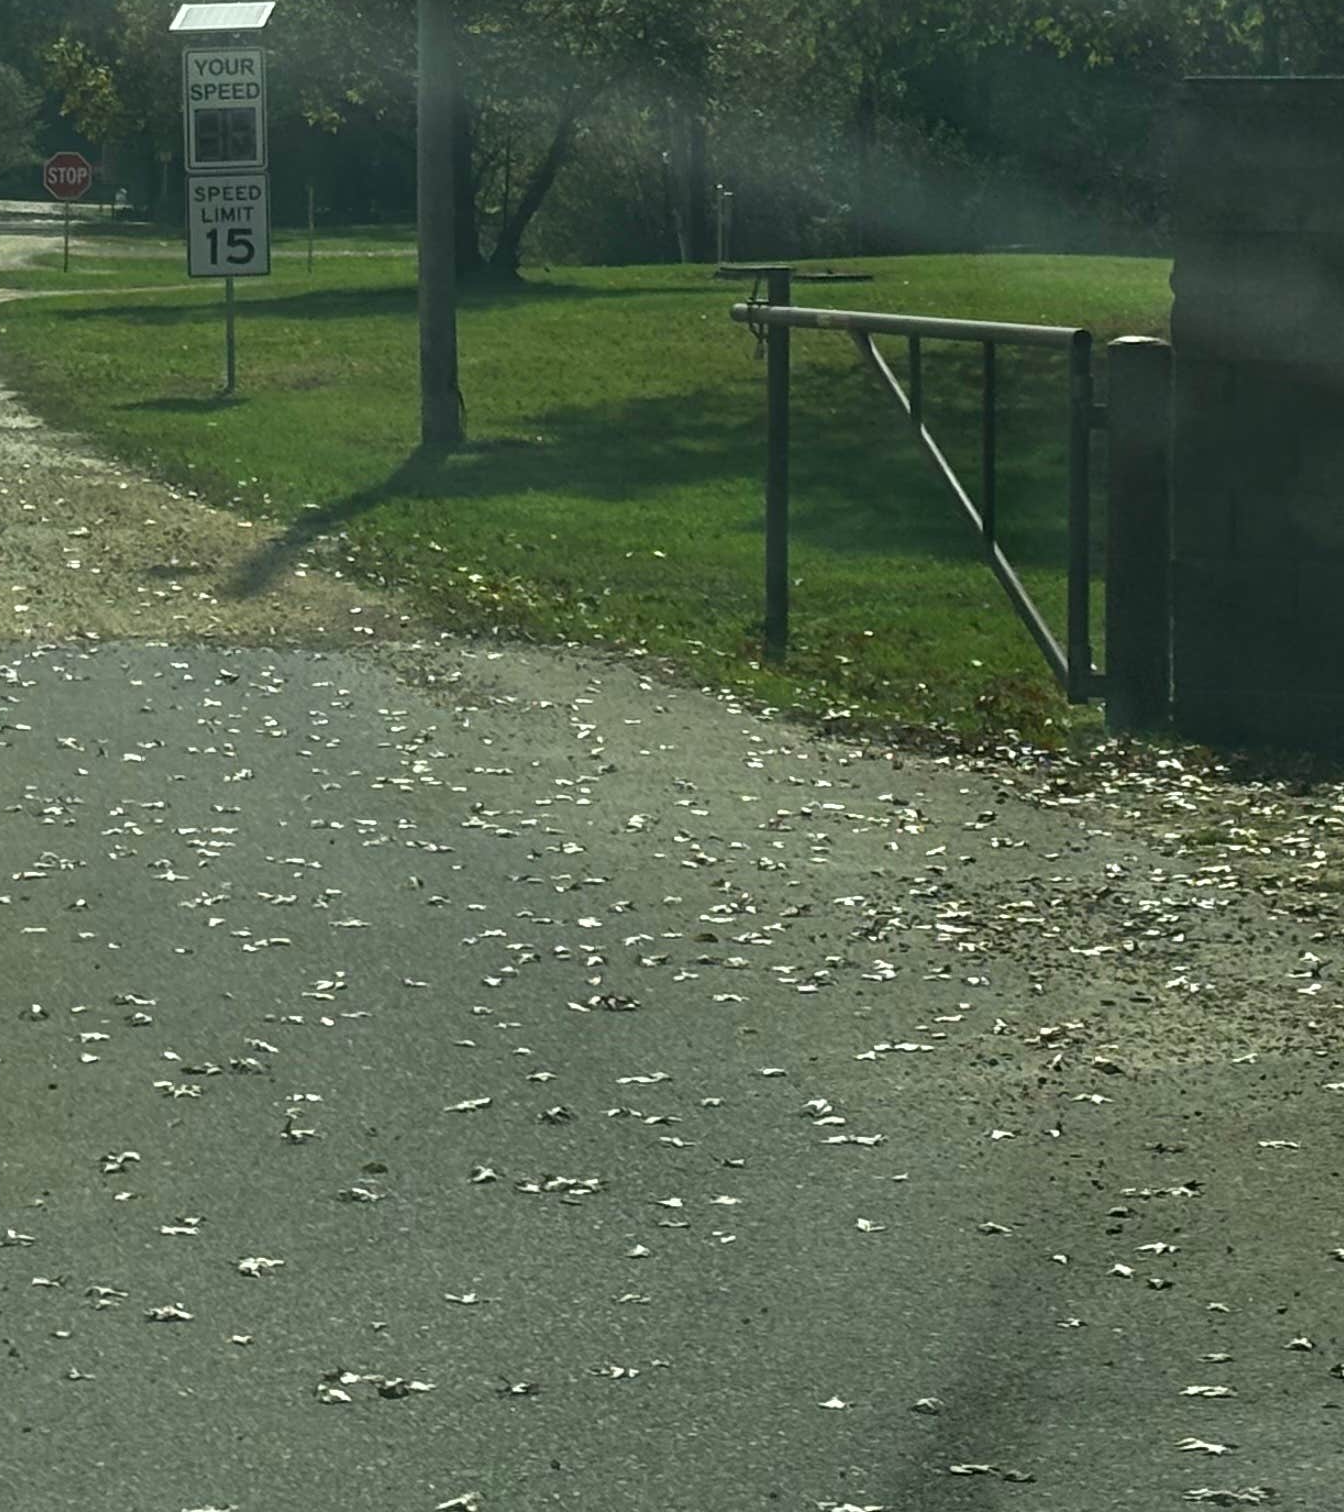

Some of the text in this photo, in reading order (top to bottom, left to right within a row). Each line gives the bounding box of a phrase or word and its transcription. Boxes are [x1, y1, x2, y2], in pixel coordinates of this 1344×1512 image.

[194, 58, 255, 76] YOUR
[190, 82, 260, 101] SPEED
[47, 167, 88, 185] STOP
[194, 185, 261, 202] SPEED
[201, 206, 254, 223] LIMIT
[206, 228, 255, 265] 15
